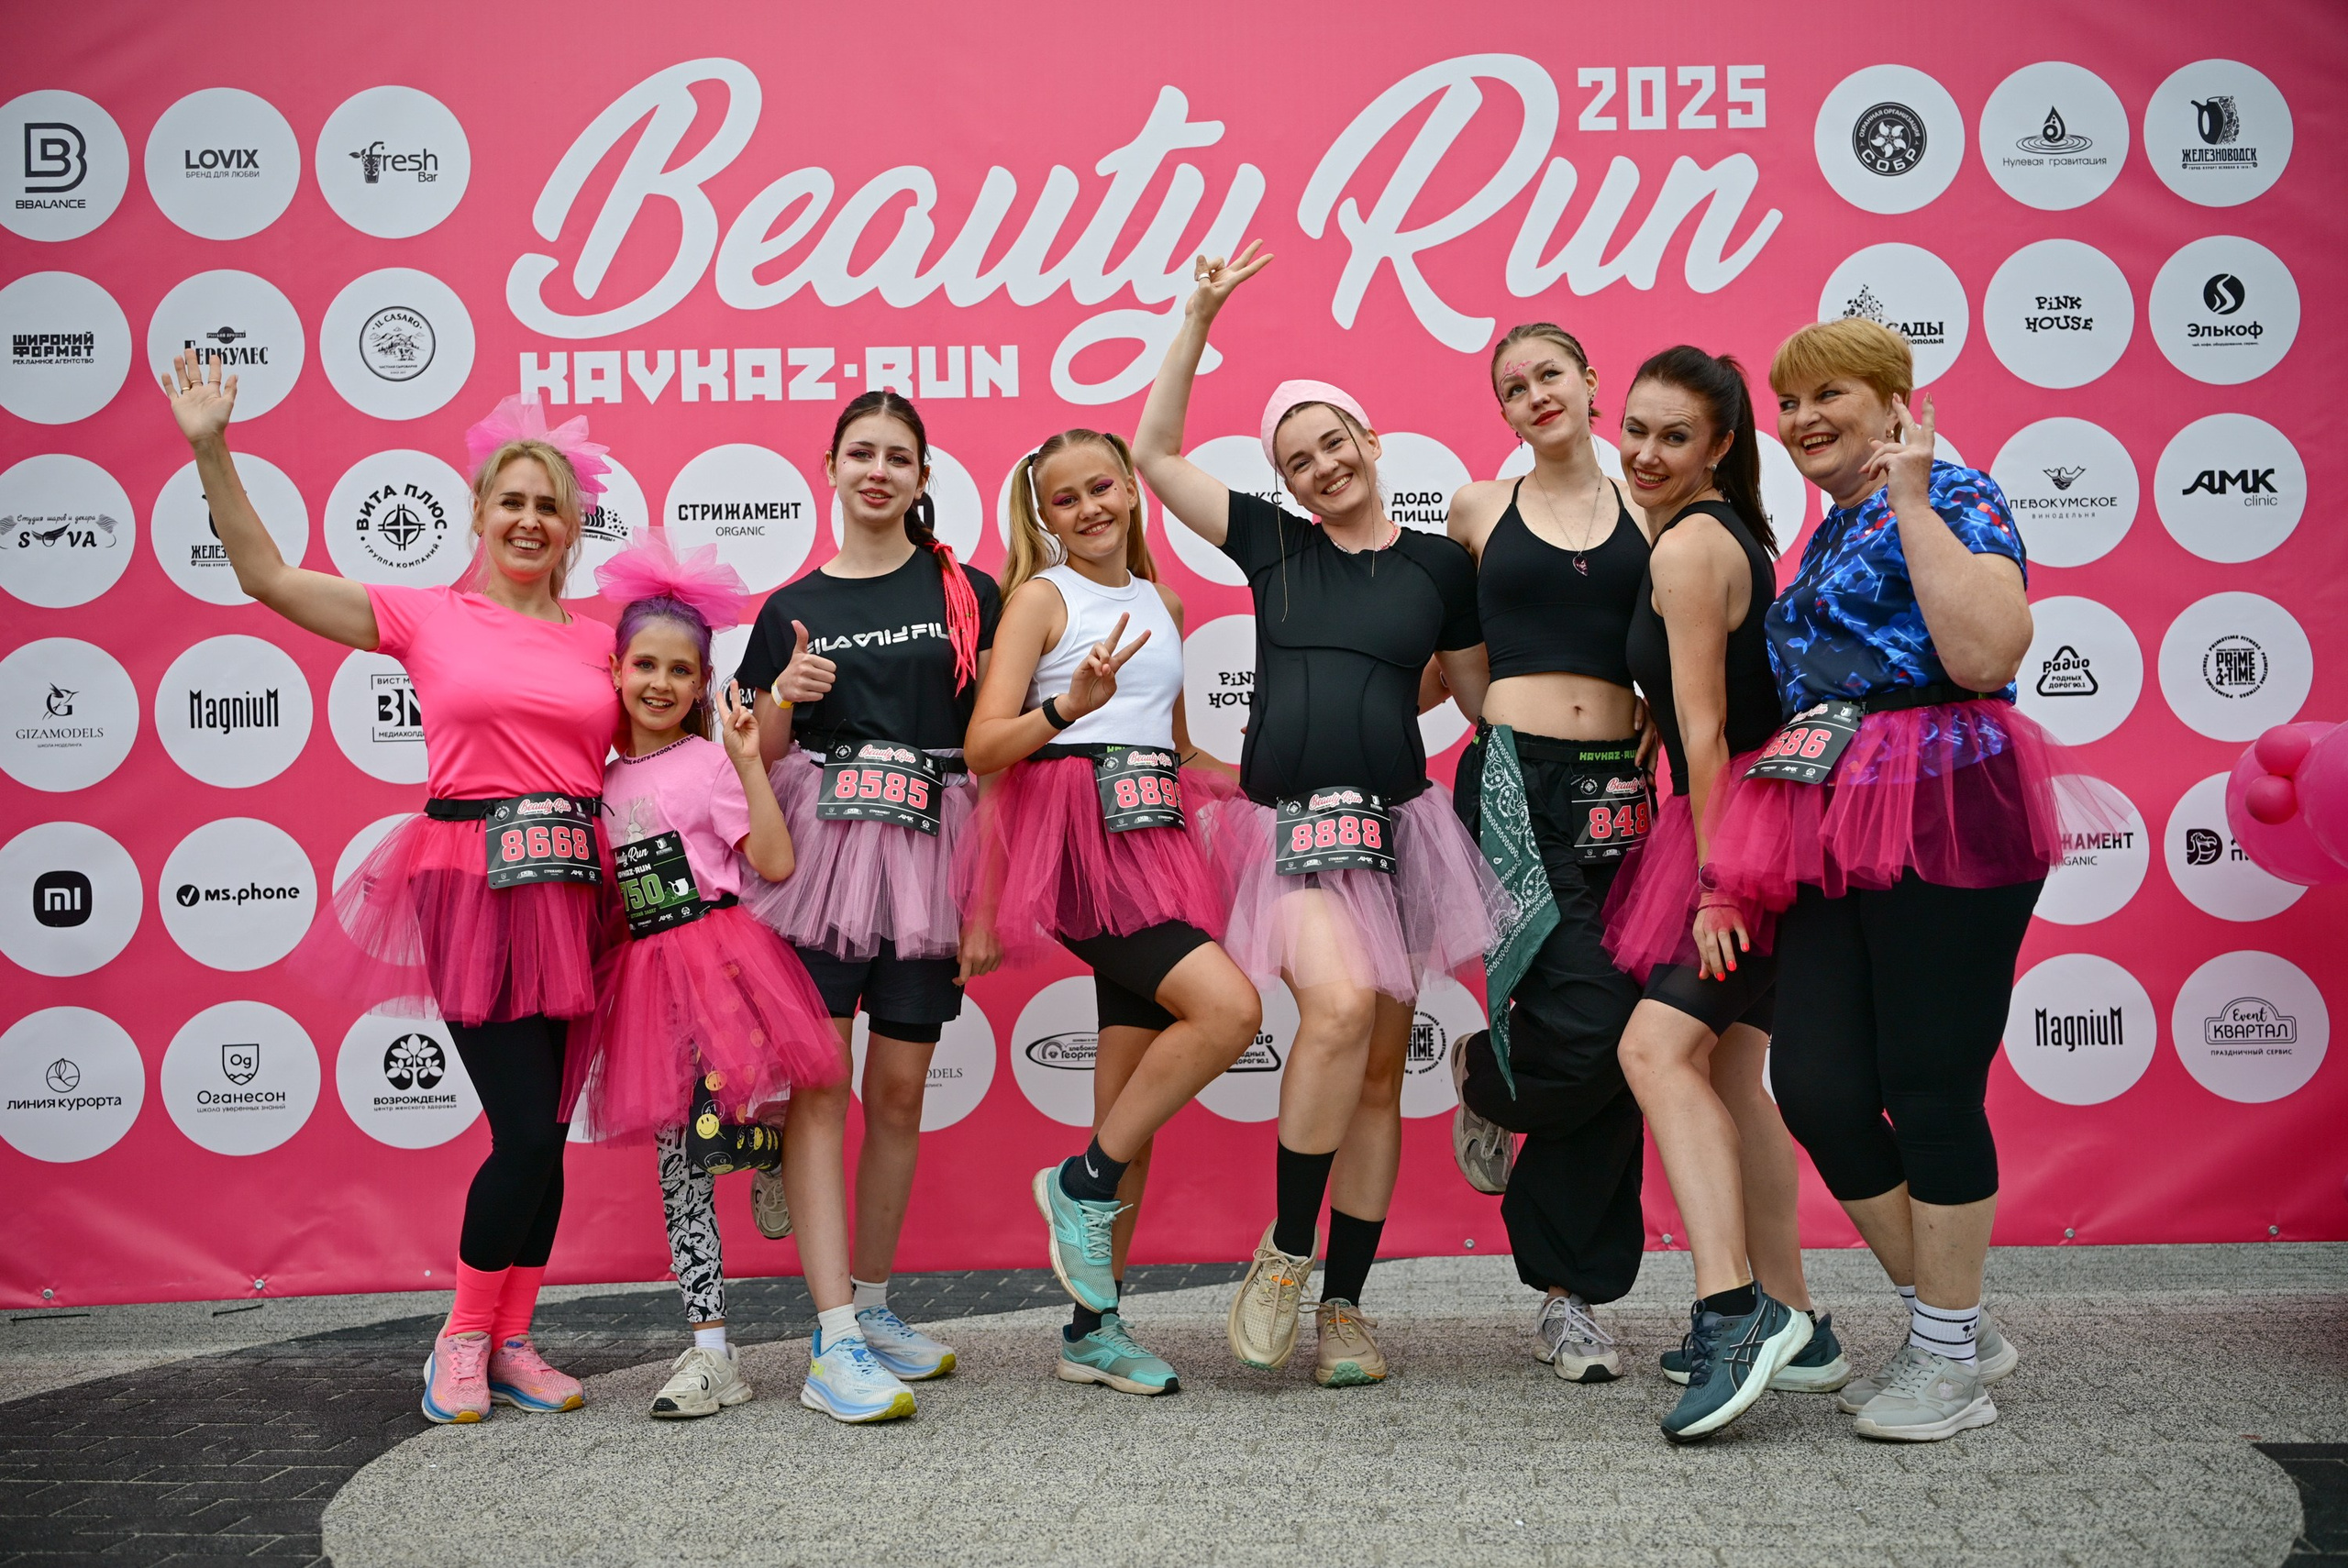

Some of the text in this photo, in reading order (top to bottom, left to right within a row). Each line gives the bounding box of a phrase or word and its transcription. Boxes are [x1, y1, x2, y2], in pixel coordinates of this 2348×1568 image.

[1578, 65, 1767, 131] 2025
[1858, 108, 1921, 138] ОХРАННАЯ ОРГАНИЗАЦИЯ
[184, 149, 260, 170] LOVIX
[1861, 148, 1916, 171] СОБР
[2002, 157, 2108, 168] Нулевая гравитация
[2181, 148, 2257, 162] ЖЕЛЕЗНОВОДСК
[185, 171, 212, 179] БРЕНД
[214, 171, 229, 179] ДЛЯ
[417, 171, 438, 182] Bar
[16, 199, 86, 209] BBALANCE
[506, 53, 1784, 405] Beauty Run
[374, 313, 420, 328] IL CASARO
[2024, 315, 2094, 333] HOUSE
[2187, 320, 2264, 339] Элькоф
[12, 331, 94, 347] ШИРОКИЙ
[12, 345, 94, 358] ФОРМАТ
[1391, 491, 1443, 506] ДОДО
[2010, 496, 2118, 509] ЛЕВОКУМСКОЕ
[2243, 493, 2278, 507] clinic
[356, 483, 448, 531] ВИТА ПЛЮС
[678, 502, 802, 521] СТРИЖАМЕНТ
[17, 513, 44, 525] Студия
[47, 513, 67, 525] шаров
[74, 514, 96, 525] декора
[2032, 512, 2096, 520] ВИНОДЕЛЬНЯ
[715, 525, 765, 536] ORGANIC
[191, 545, 227, 559] ЖЕЛЕЗ
[364, 543, 440, 569] ГРУППА КОМПАНИЙ
[911, 622, 949, 640] FIL
[2043, 657, 2090, 673] Радио
[1208, 691, 1254, 708] HOU
[15, 727, 105, 740] GIZAMODELS
[656, 745, 672, 756] COOL
[1762, 727, 1833, 759] 686
[858, 744, 894, 762] Beauty
[893, 748, 916, 764] Run
[1126, 750, 1158, 767] Beauty
[835, 769, 929, 811] 8585
[1606, 777, 1639, 795] Beauty
[517, 798, 553, 815] Beauty
[1308, 791, 1340, 811] Beauty
[1339, 790, 1364, 805] Run
[1589, 801, 1649, 839] 848
[1291, 815, 1382, 853] 8888
[2061, 832, 2134, 850] ЖАМЕНТ
[501, 825, 590, 862] 8668
[627, 845, 649, 862] Run
[2063, 856, 2099, 867] GANIC
[2232, 1006, 2268, 1022] Event
[2213, 1023, 2288, 1039] КВАРТАЛ
[2210, 1048, 2264, 1056] ПРАЗДНИЧНЫЙ
[230, 1054, 252, 1069] Og
[926, 1067, 963, 1079] ODELS
[6, 1096, 122, 1111] линия курорта
[196, 1089, 286, 1105] Оганесон
[373, 1094, 457, 1106] ВОЗРОЖДЕНИЕ
